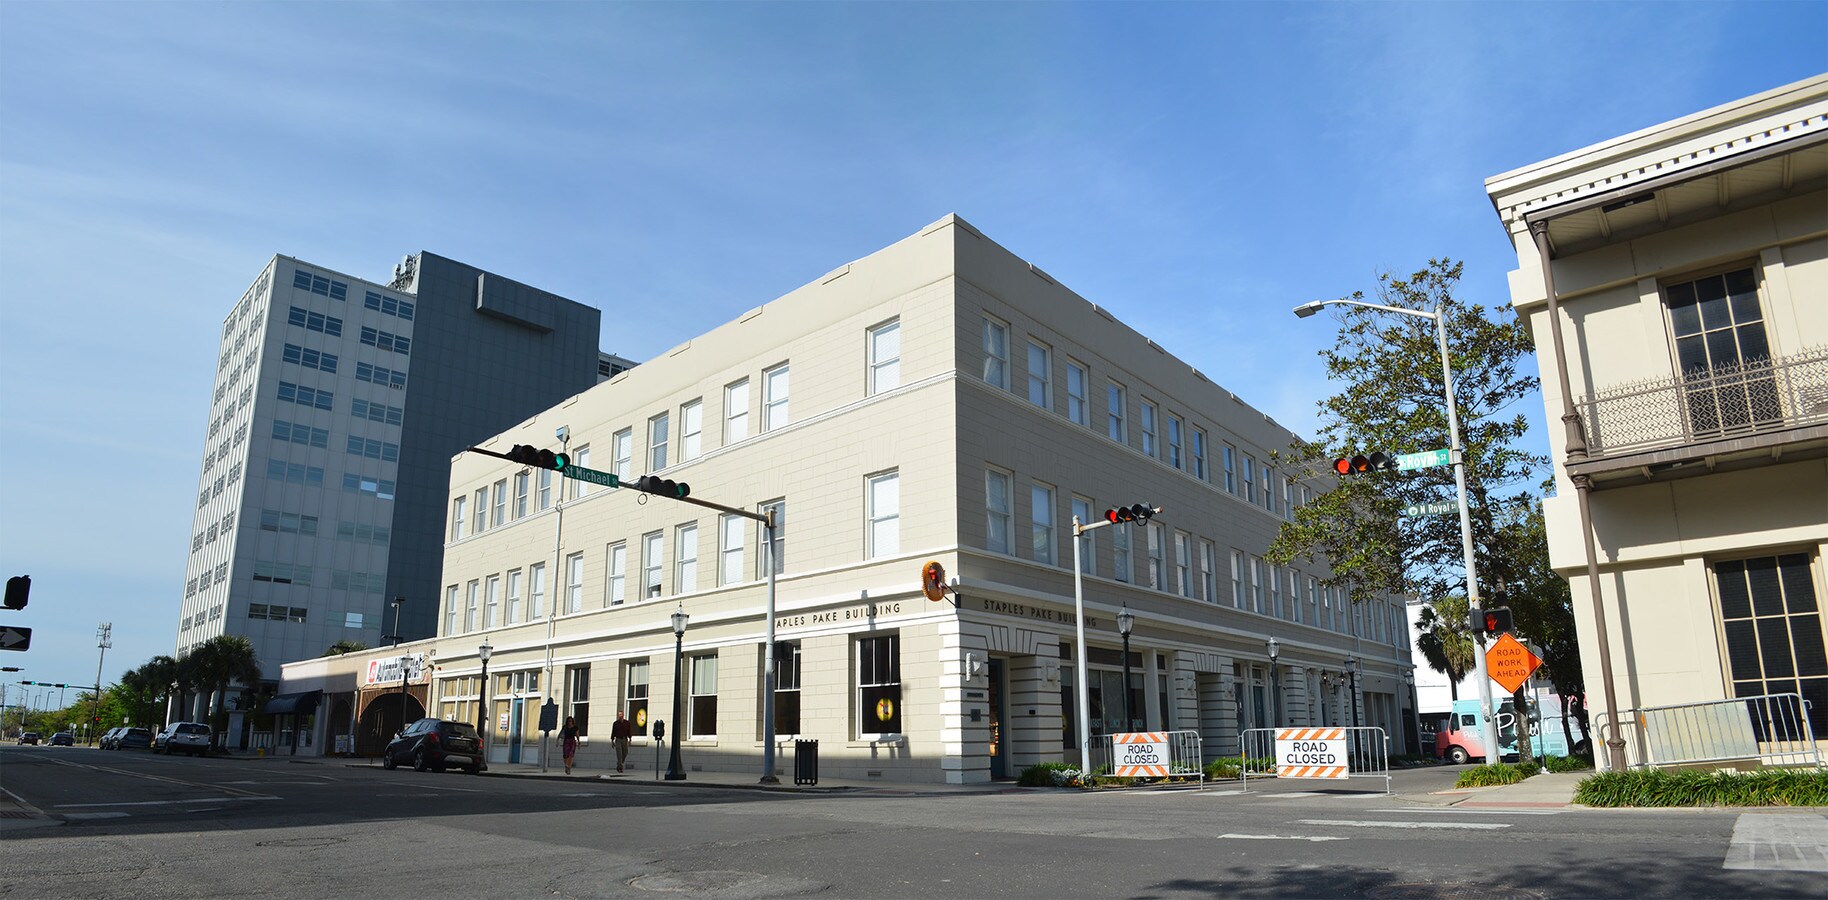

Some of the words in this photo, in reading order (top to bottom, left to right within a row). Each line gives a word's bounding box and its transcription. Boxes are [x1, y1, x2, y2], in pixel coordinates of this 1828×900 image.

[1440, 453, 1447, 461] St
[564, 466, 574, 478] St
[576, 467, 610, 486] Michael
[1420, 505, 1426, 514] N
[1428, 502, 1450, 515] Royal
[776, 616, 805, 629] APLES
[813, 611, 838, 624] PAKE
[845, 603, 901, 620] BUILDING
[984, 599, 1024, 616] STAPLES
[1031, 607, 1052, 620] PAKE
[1058, 611, 1097, 627] BUILNG
[1496, 648, 1522, 657] ROAD
[1496, 659, 1522, 667] WORK
[1496, 669, 1527, 678] AHEAD
[1127, 744, 1154, 755] ROAD
[1293, 742, 1328, 753] ROAD
[1123, 754, 1160, 765] CLOSED
[1286, 753, 1336, 765] CLOSED
